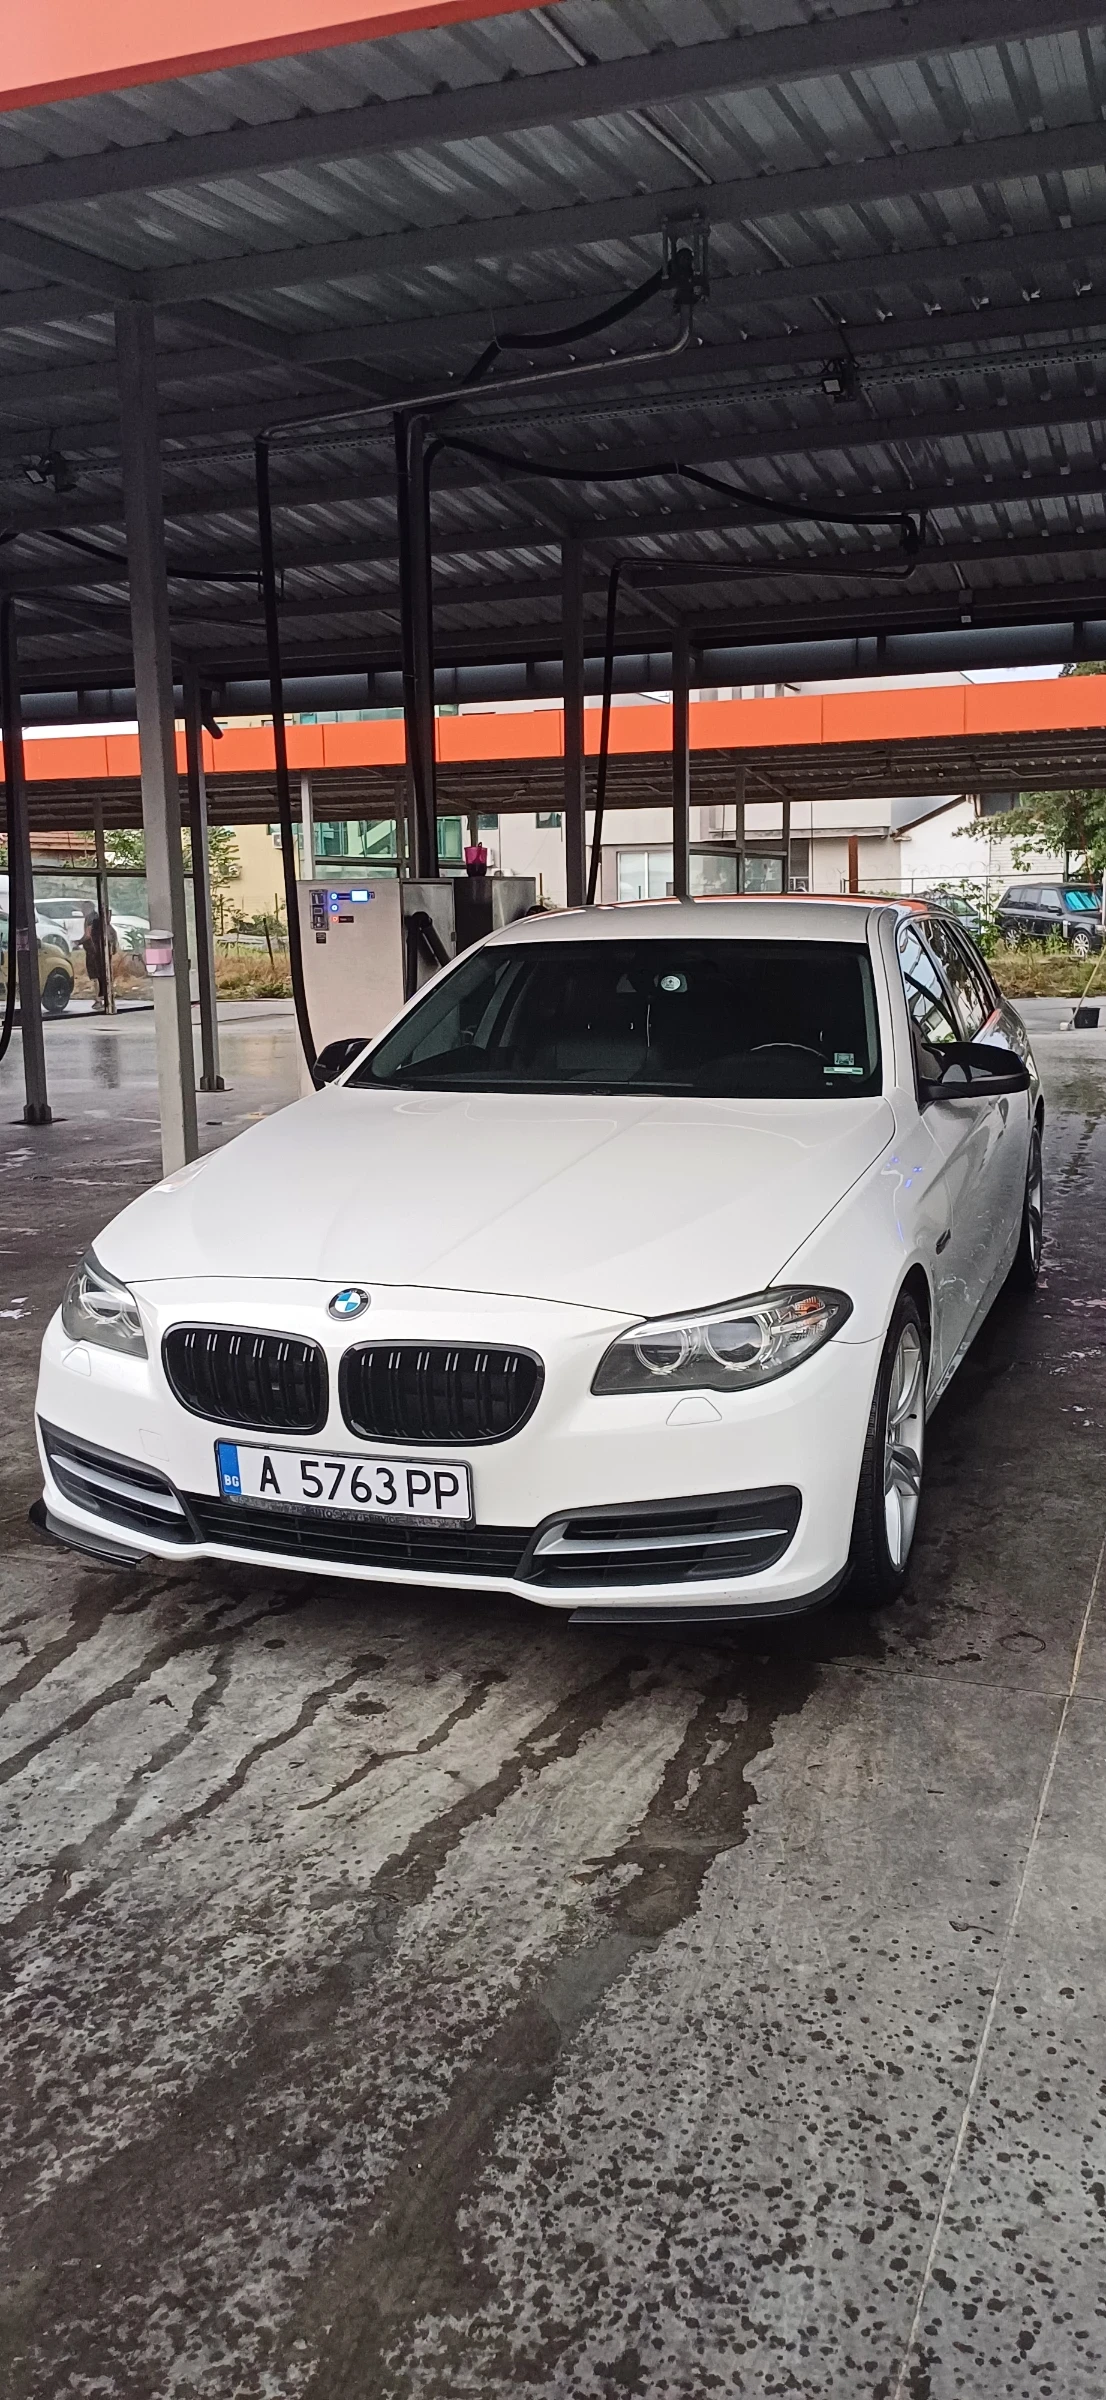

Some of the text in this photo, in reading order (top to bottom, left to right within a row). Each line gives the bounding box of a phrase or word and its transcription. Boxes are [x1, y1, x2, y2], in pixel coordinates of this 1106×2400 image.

[224, 1474, 240, 1488] BG
[260, 1456, 459, 1509] A 5763 PP
